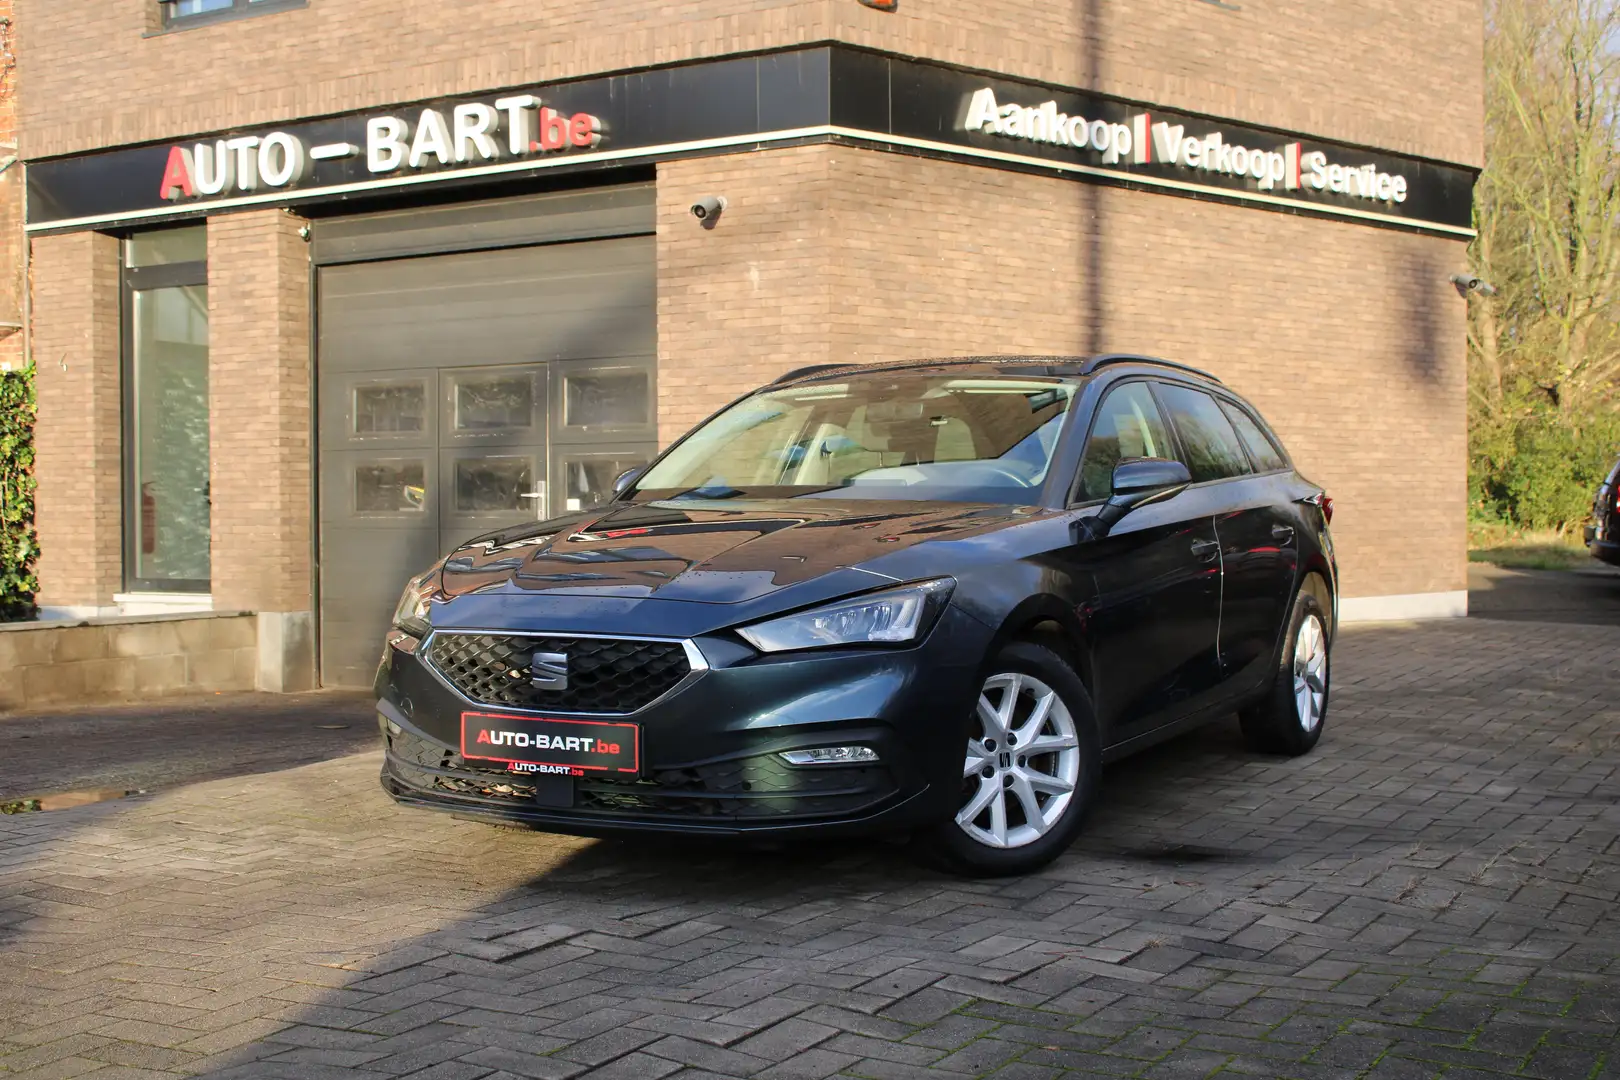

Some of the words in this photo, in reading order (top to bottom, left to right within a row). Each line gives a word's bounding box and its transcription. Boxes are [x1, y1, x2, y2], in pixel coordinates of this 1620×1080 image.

[965, 87, 1132, 164] Aankoop
[1151, 120, 1284, 190] Verkoop
[1302, 150, 1407, 203] Service
[477, 729, 620, 754] AUTO-BART.be
[507, 762, 584, 776] AUTO-BART.be
